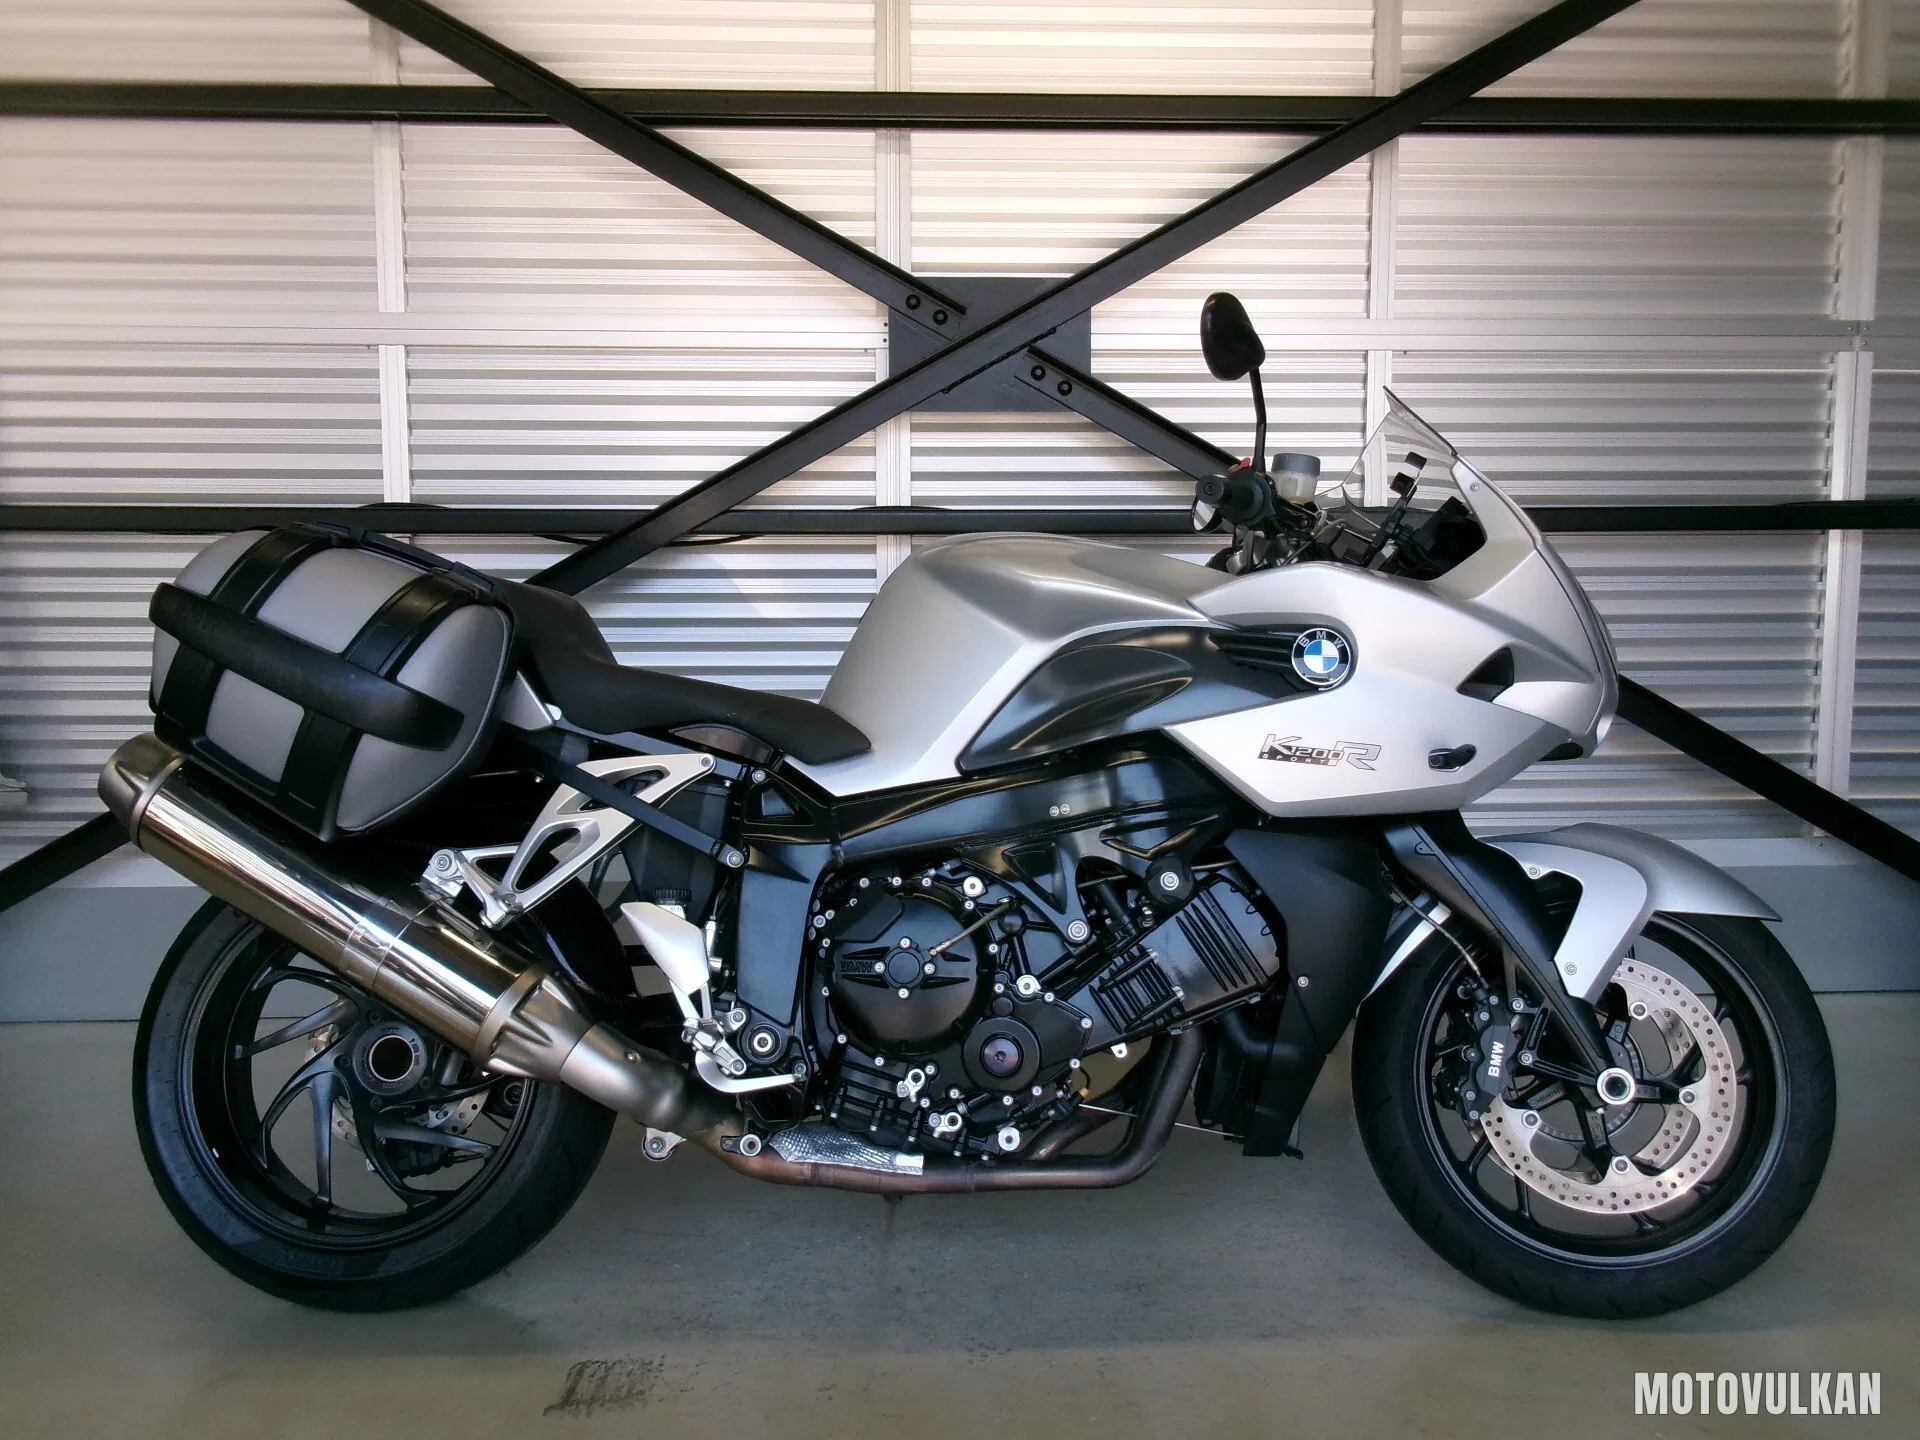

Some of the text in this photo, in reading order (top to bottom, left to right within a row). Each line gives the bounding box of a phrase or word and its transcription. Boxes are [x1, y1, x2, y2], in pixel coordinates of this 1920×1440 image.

[1299, 630, 1345, 648] BMW
[1260, 753, 1327, 765] SPORT
[840, 960, 873, 973] BMW
[1487, 1041, 1504, 1077] BMW
